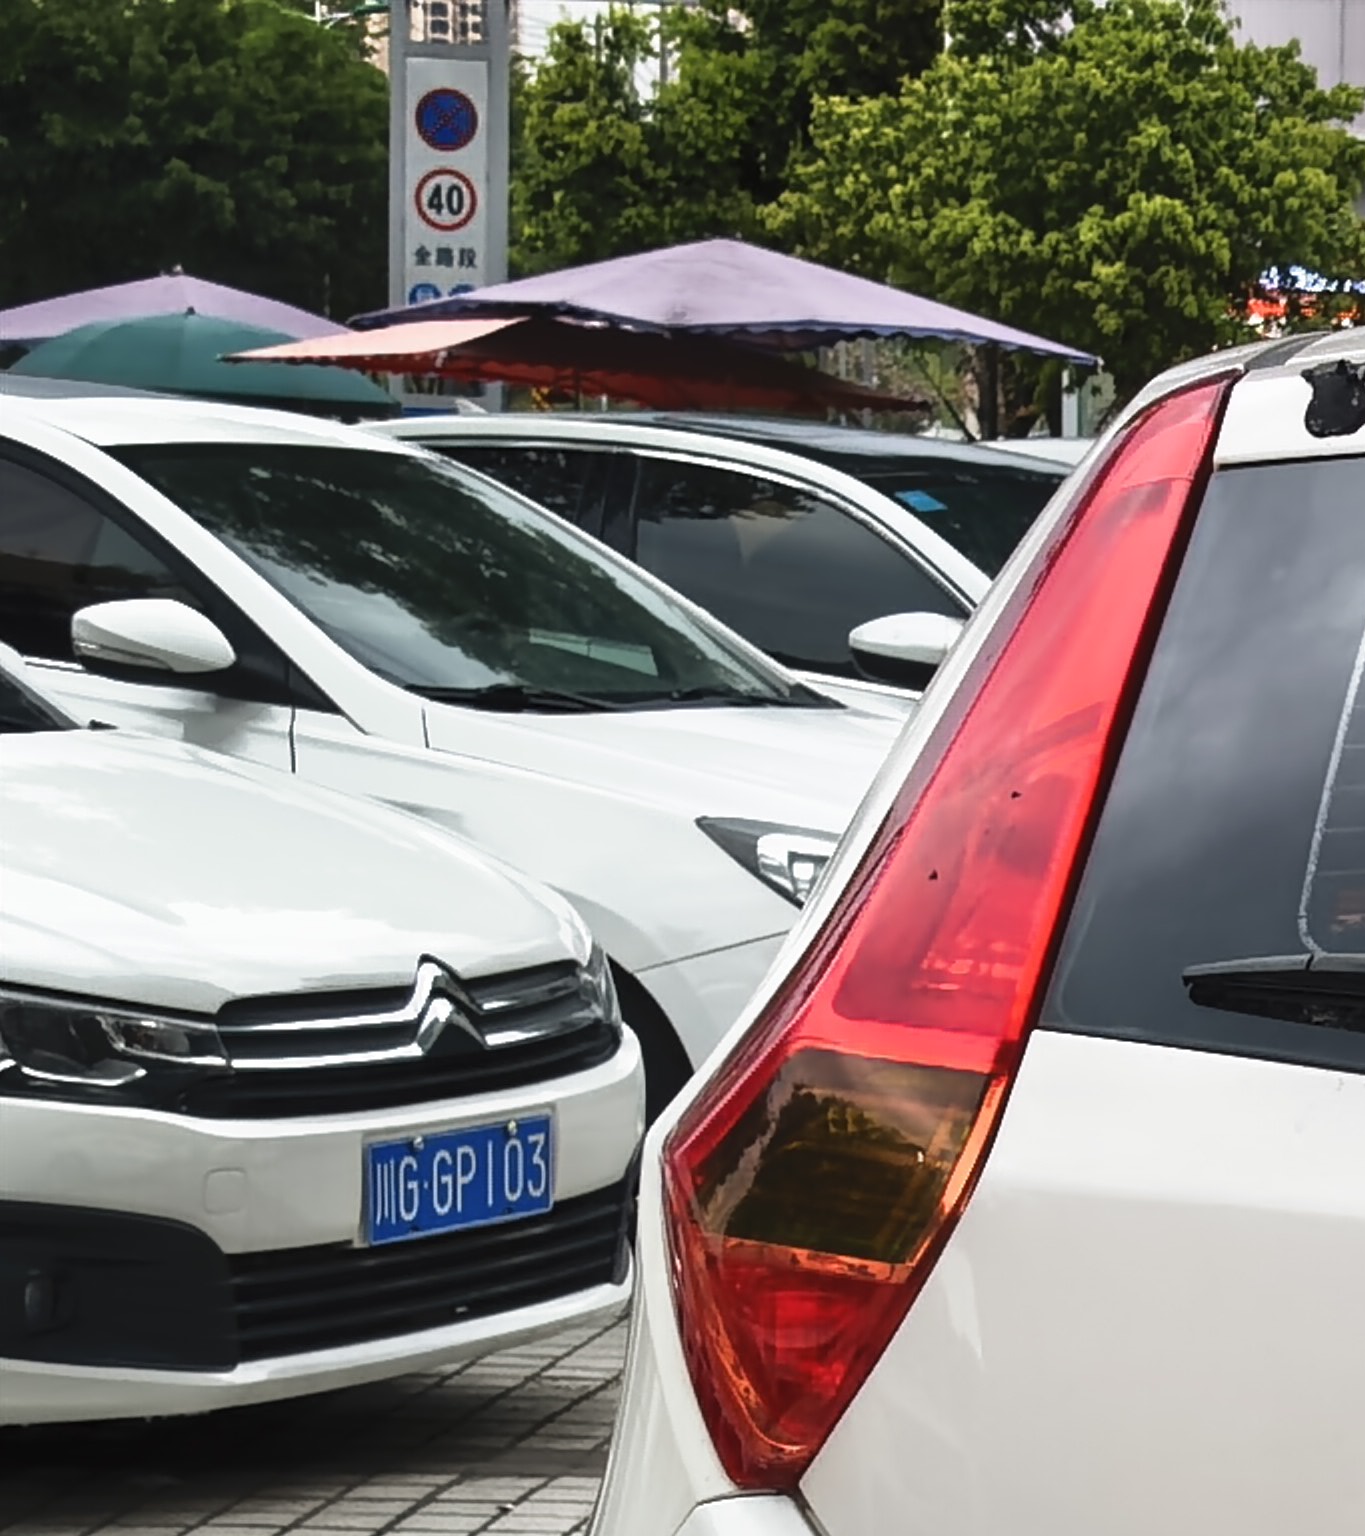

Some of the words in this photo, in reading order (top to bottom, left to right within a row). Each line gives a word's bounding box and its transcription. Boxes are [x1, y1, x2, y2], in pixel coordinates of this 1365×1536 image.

[427, 183, 464, 217] 40
[414, 244, 478, 270] 全路段
